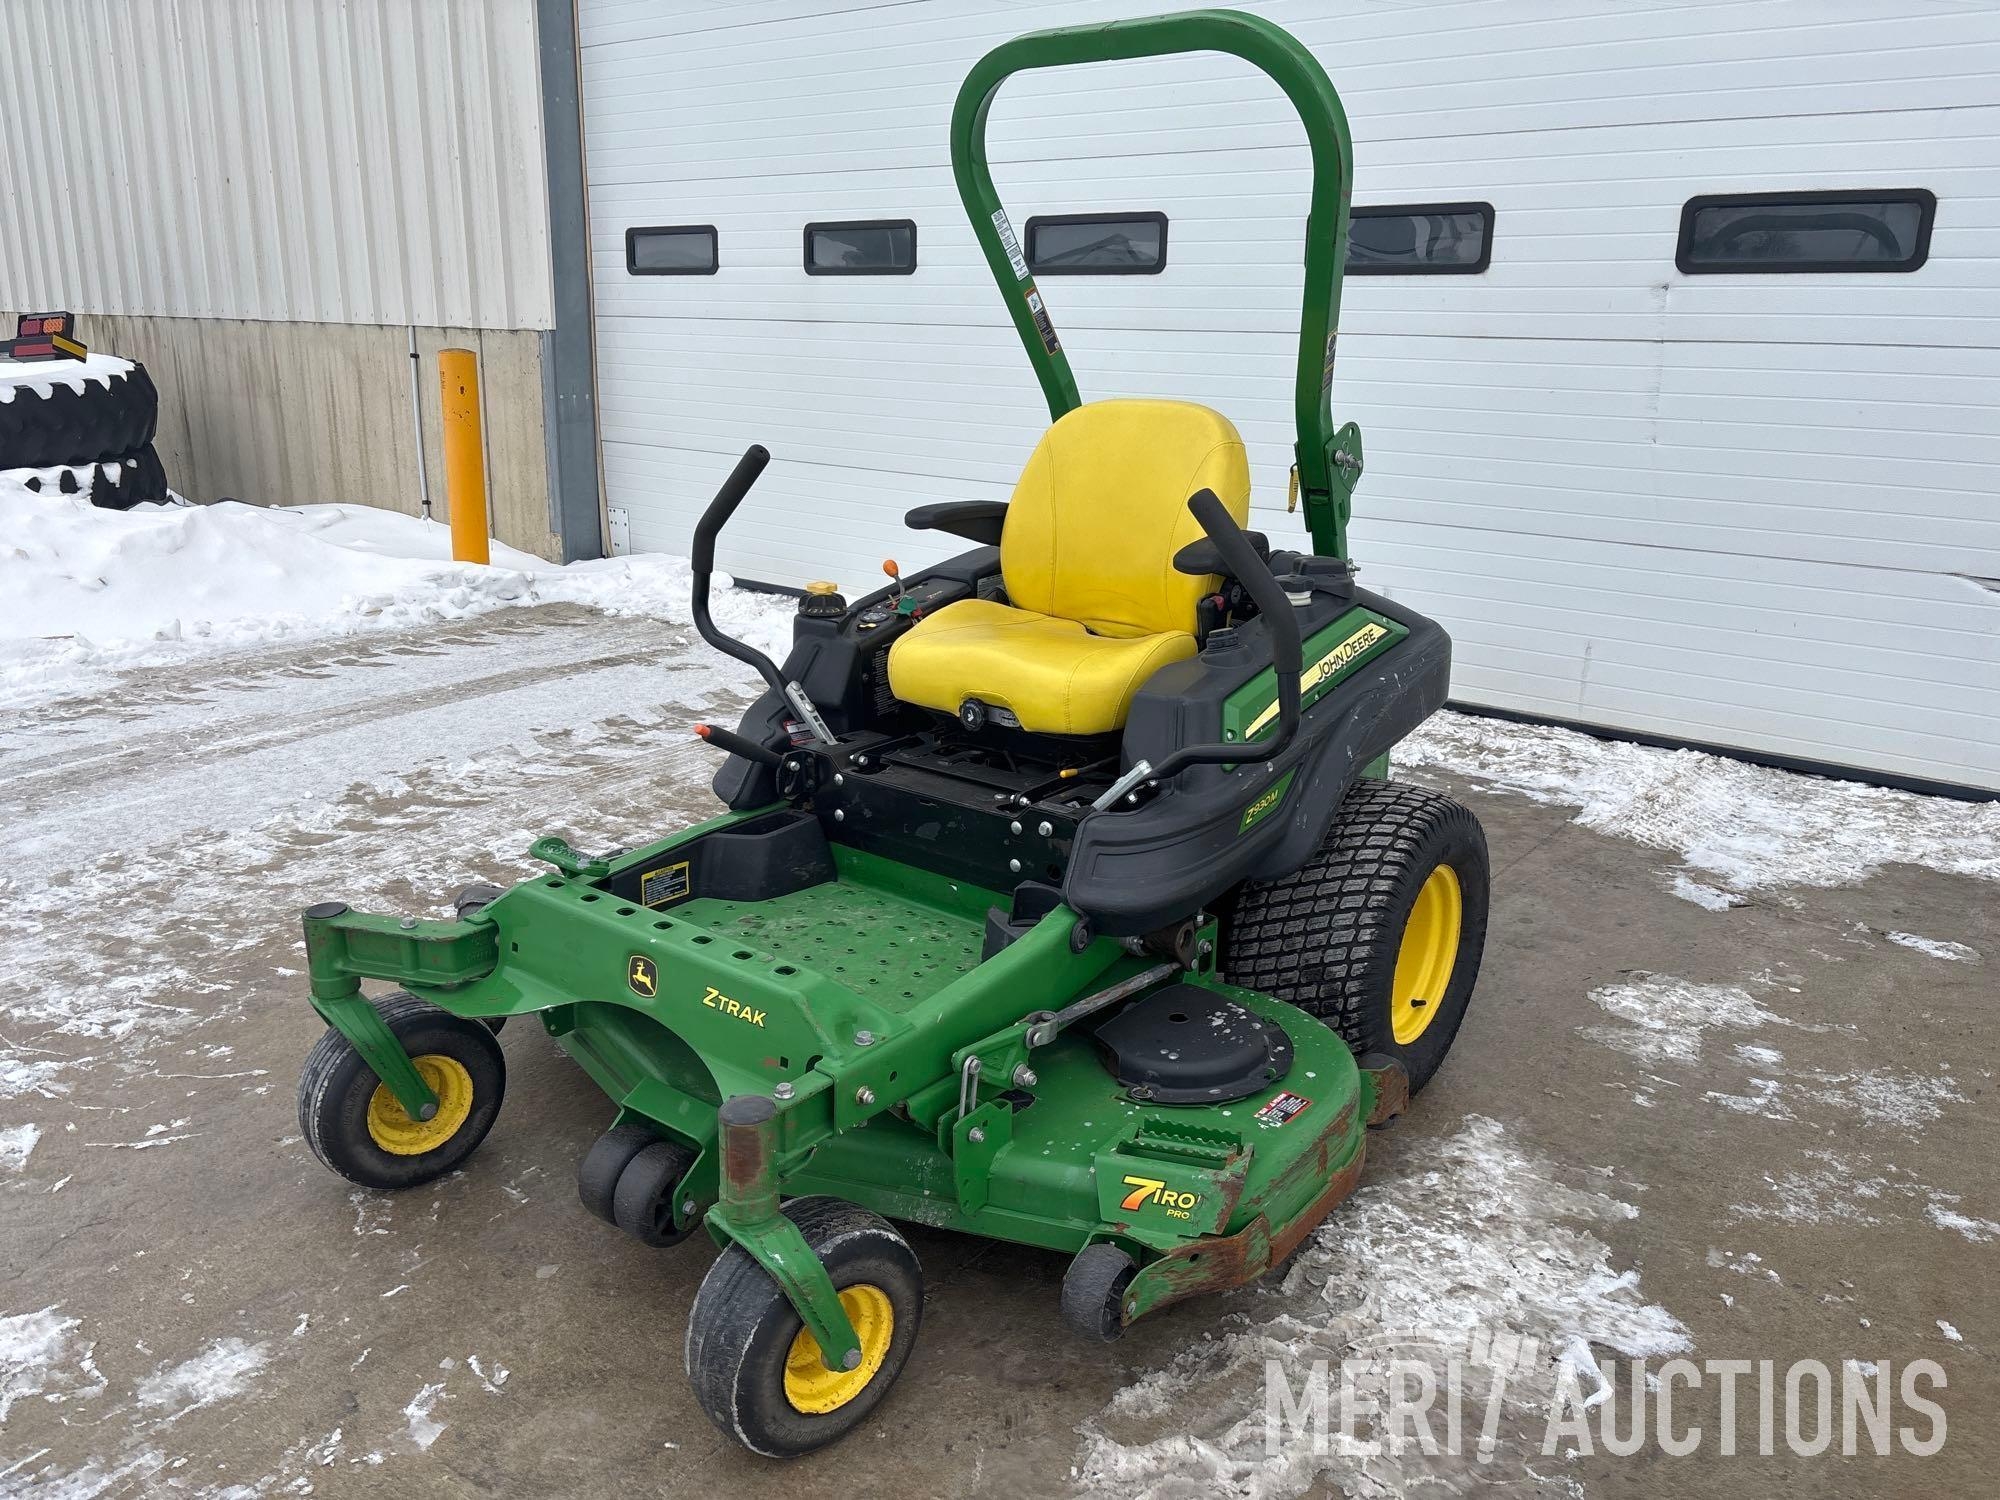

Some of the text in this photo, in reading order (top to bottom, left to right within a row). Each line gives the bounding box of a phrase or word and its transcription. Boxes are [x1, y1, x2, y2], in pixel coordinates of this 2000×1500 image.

[1317, 628, 1377, 682] JOHN DEERE
[1245, 788, 1279, 825] Z930M
[702, 986, 767, 1028] ZTRAK
[1166, 1208, 1190, 1220] PRO
